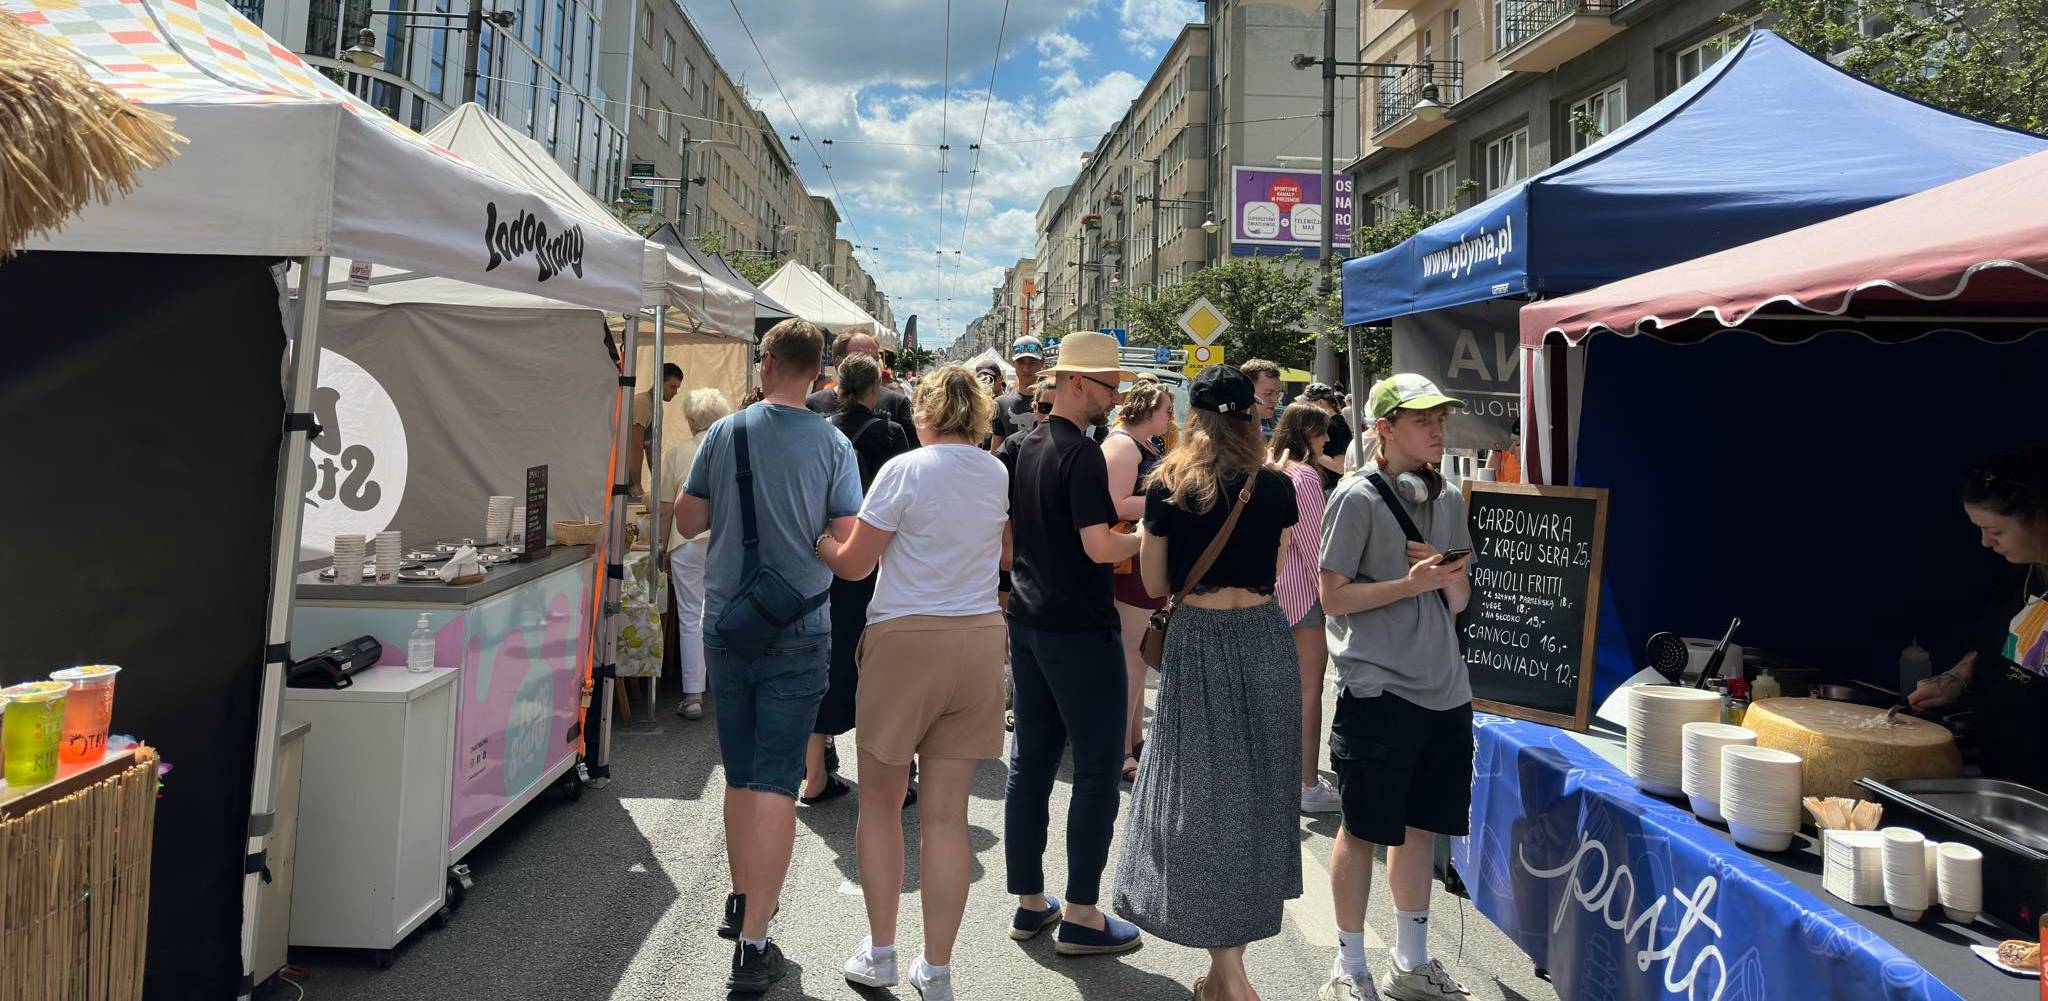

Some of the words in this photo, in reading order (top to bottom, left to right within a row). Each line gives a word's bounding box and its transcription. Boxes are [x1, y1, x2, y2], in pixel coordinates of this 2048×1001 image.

[1423, 215, 1513, 279] www.gdynia.pl
[1478, 506, 1572, 543] CARBONARA
[1494, 537, 1533, 565] KRĘGU
[1537, 543, 1570, 568] SERA
[1474, 567, 1523, 593] RAVIOLI
[1528, 574, 1563, 597] FRITTI
[1485, 612, 1494, 620] NA
[1468, 623, 1530, 649] CANNOLO
[1467, 649, 1549, 681] LEMONIADY
